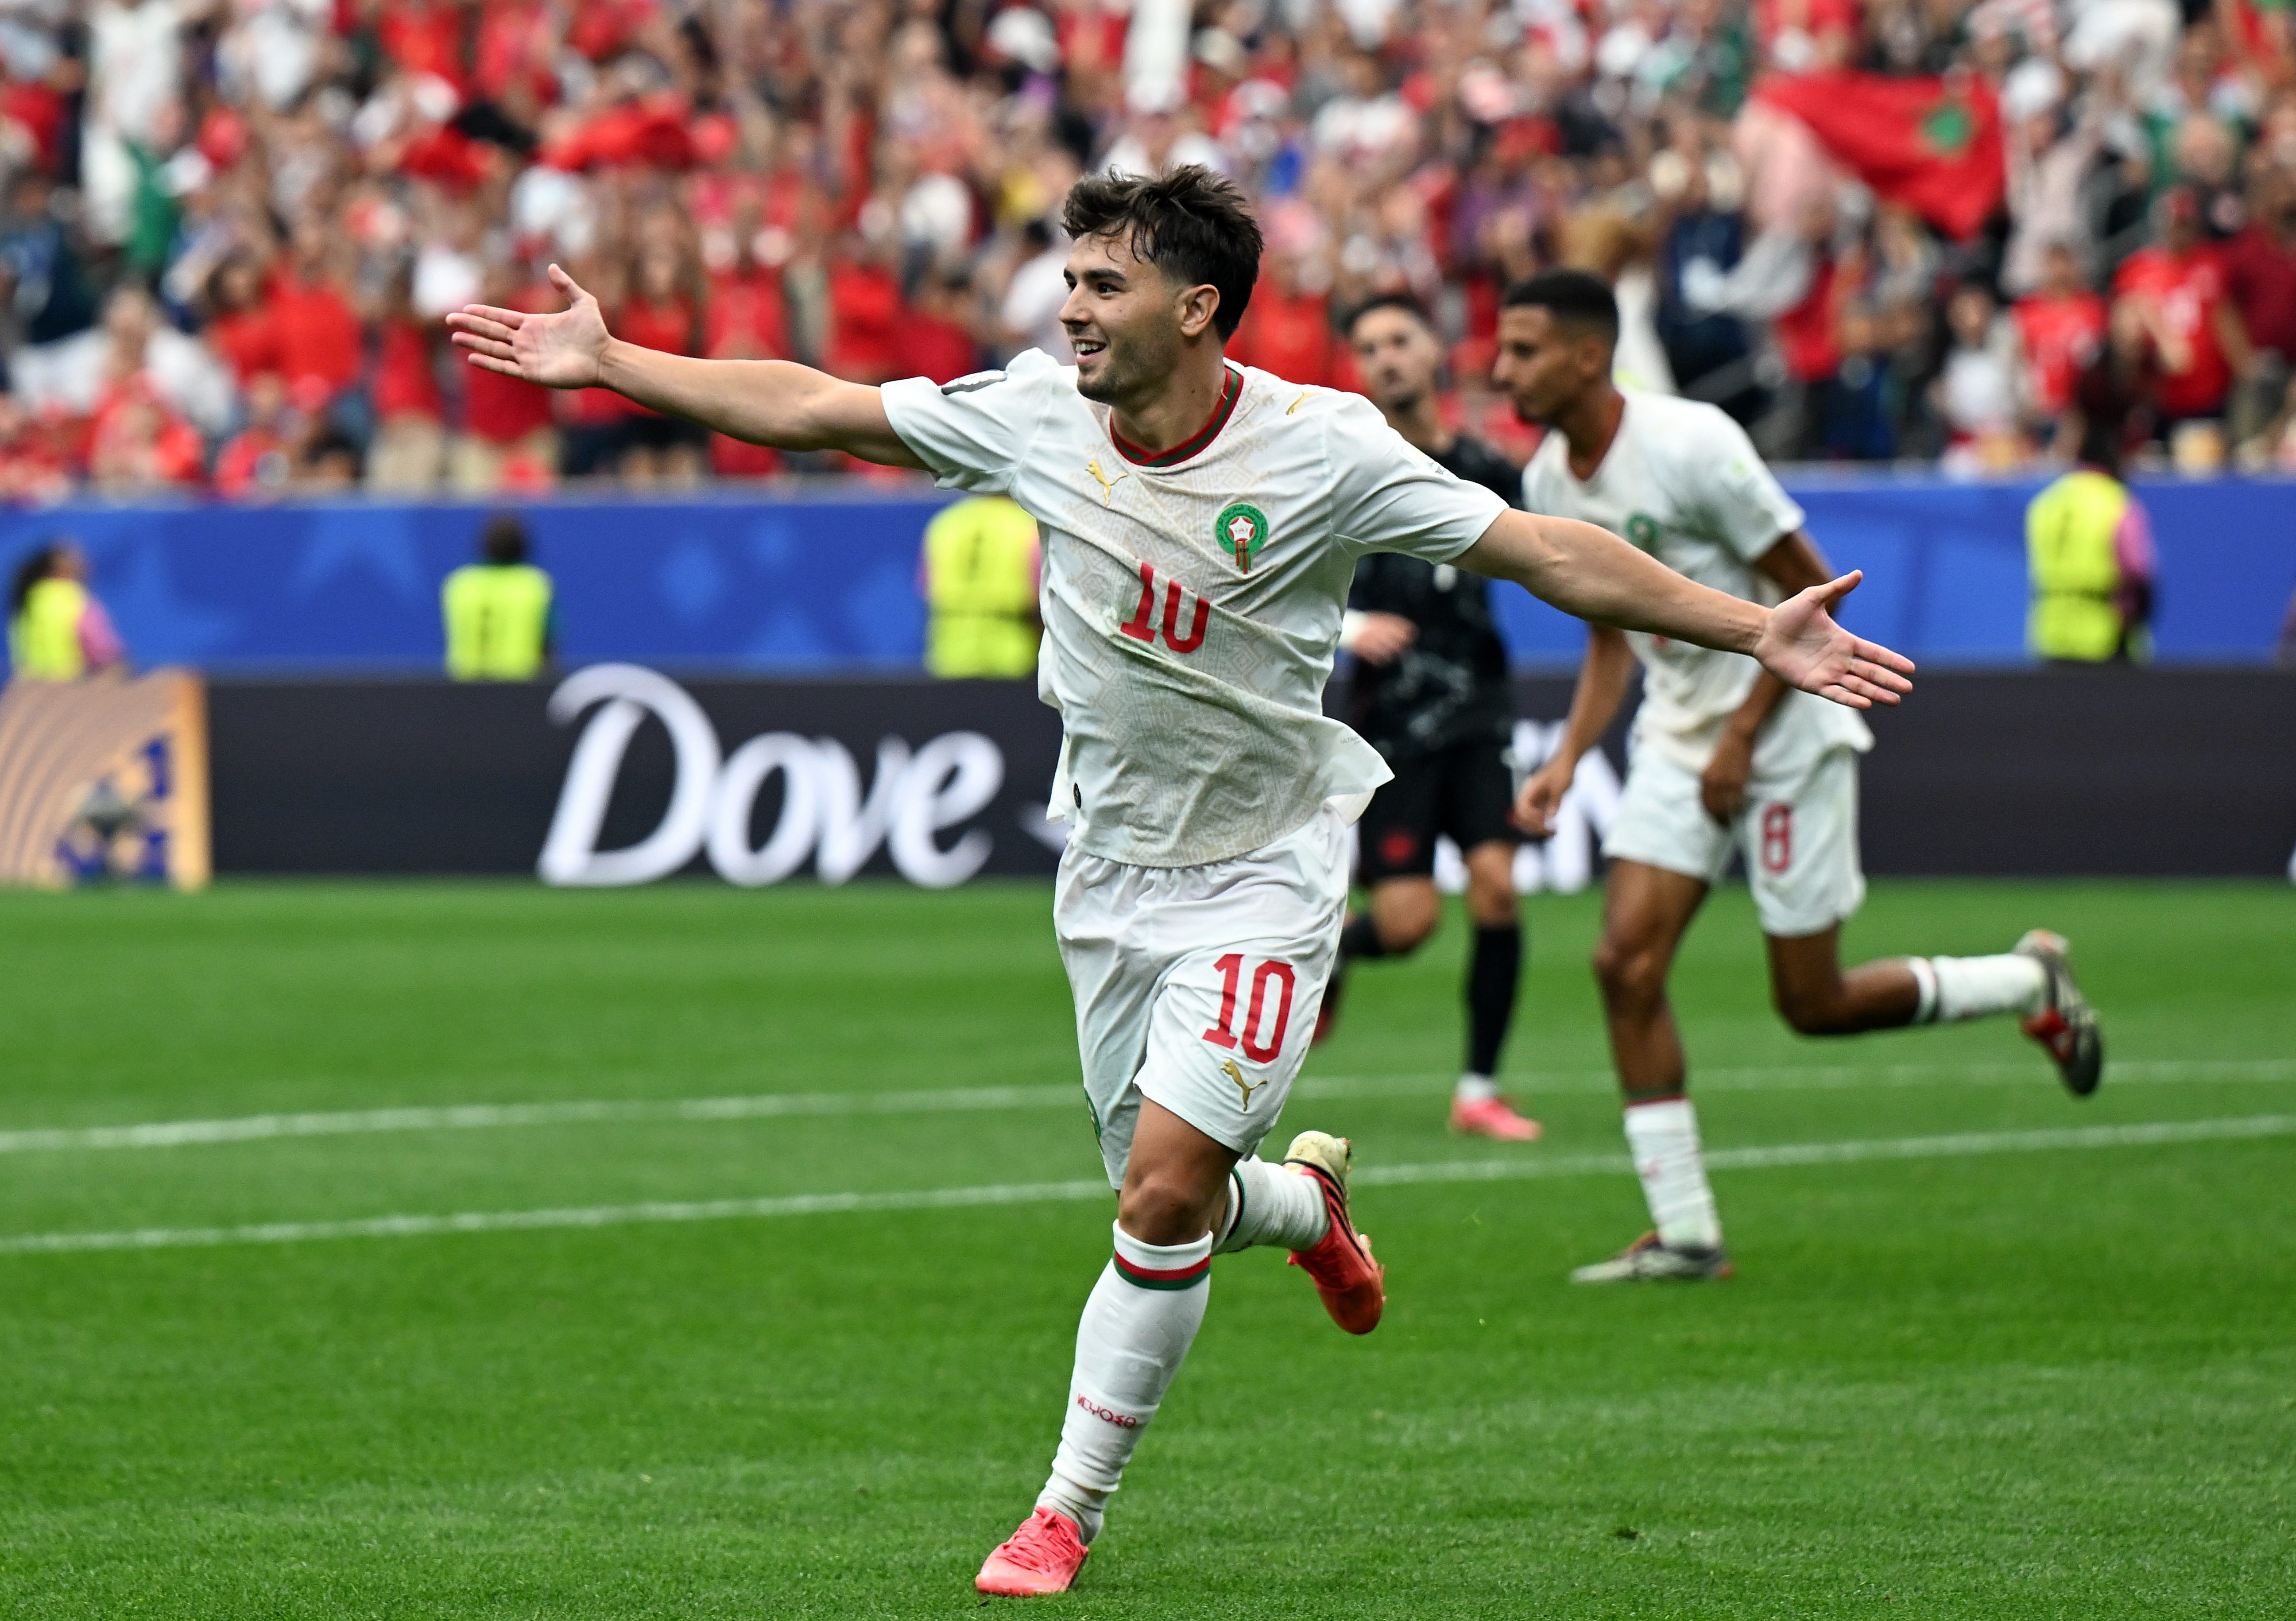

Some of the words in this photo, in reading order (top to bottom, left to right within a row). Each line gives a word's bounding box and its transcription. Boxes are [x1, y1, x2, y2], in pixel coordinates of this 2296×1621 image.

[1121, 562, 1210, 653] 10
[537, 663, 1005, 887] Dove
[1763, 804, 1791, 873] 8
[1202, 954, 1295, 1064] 10
